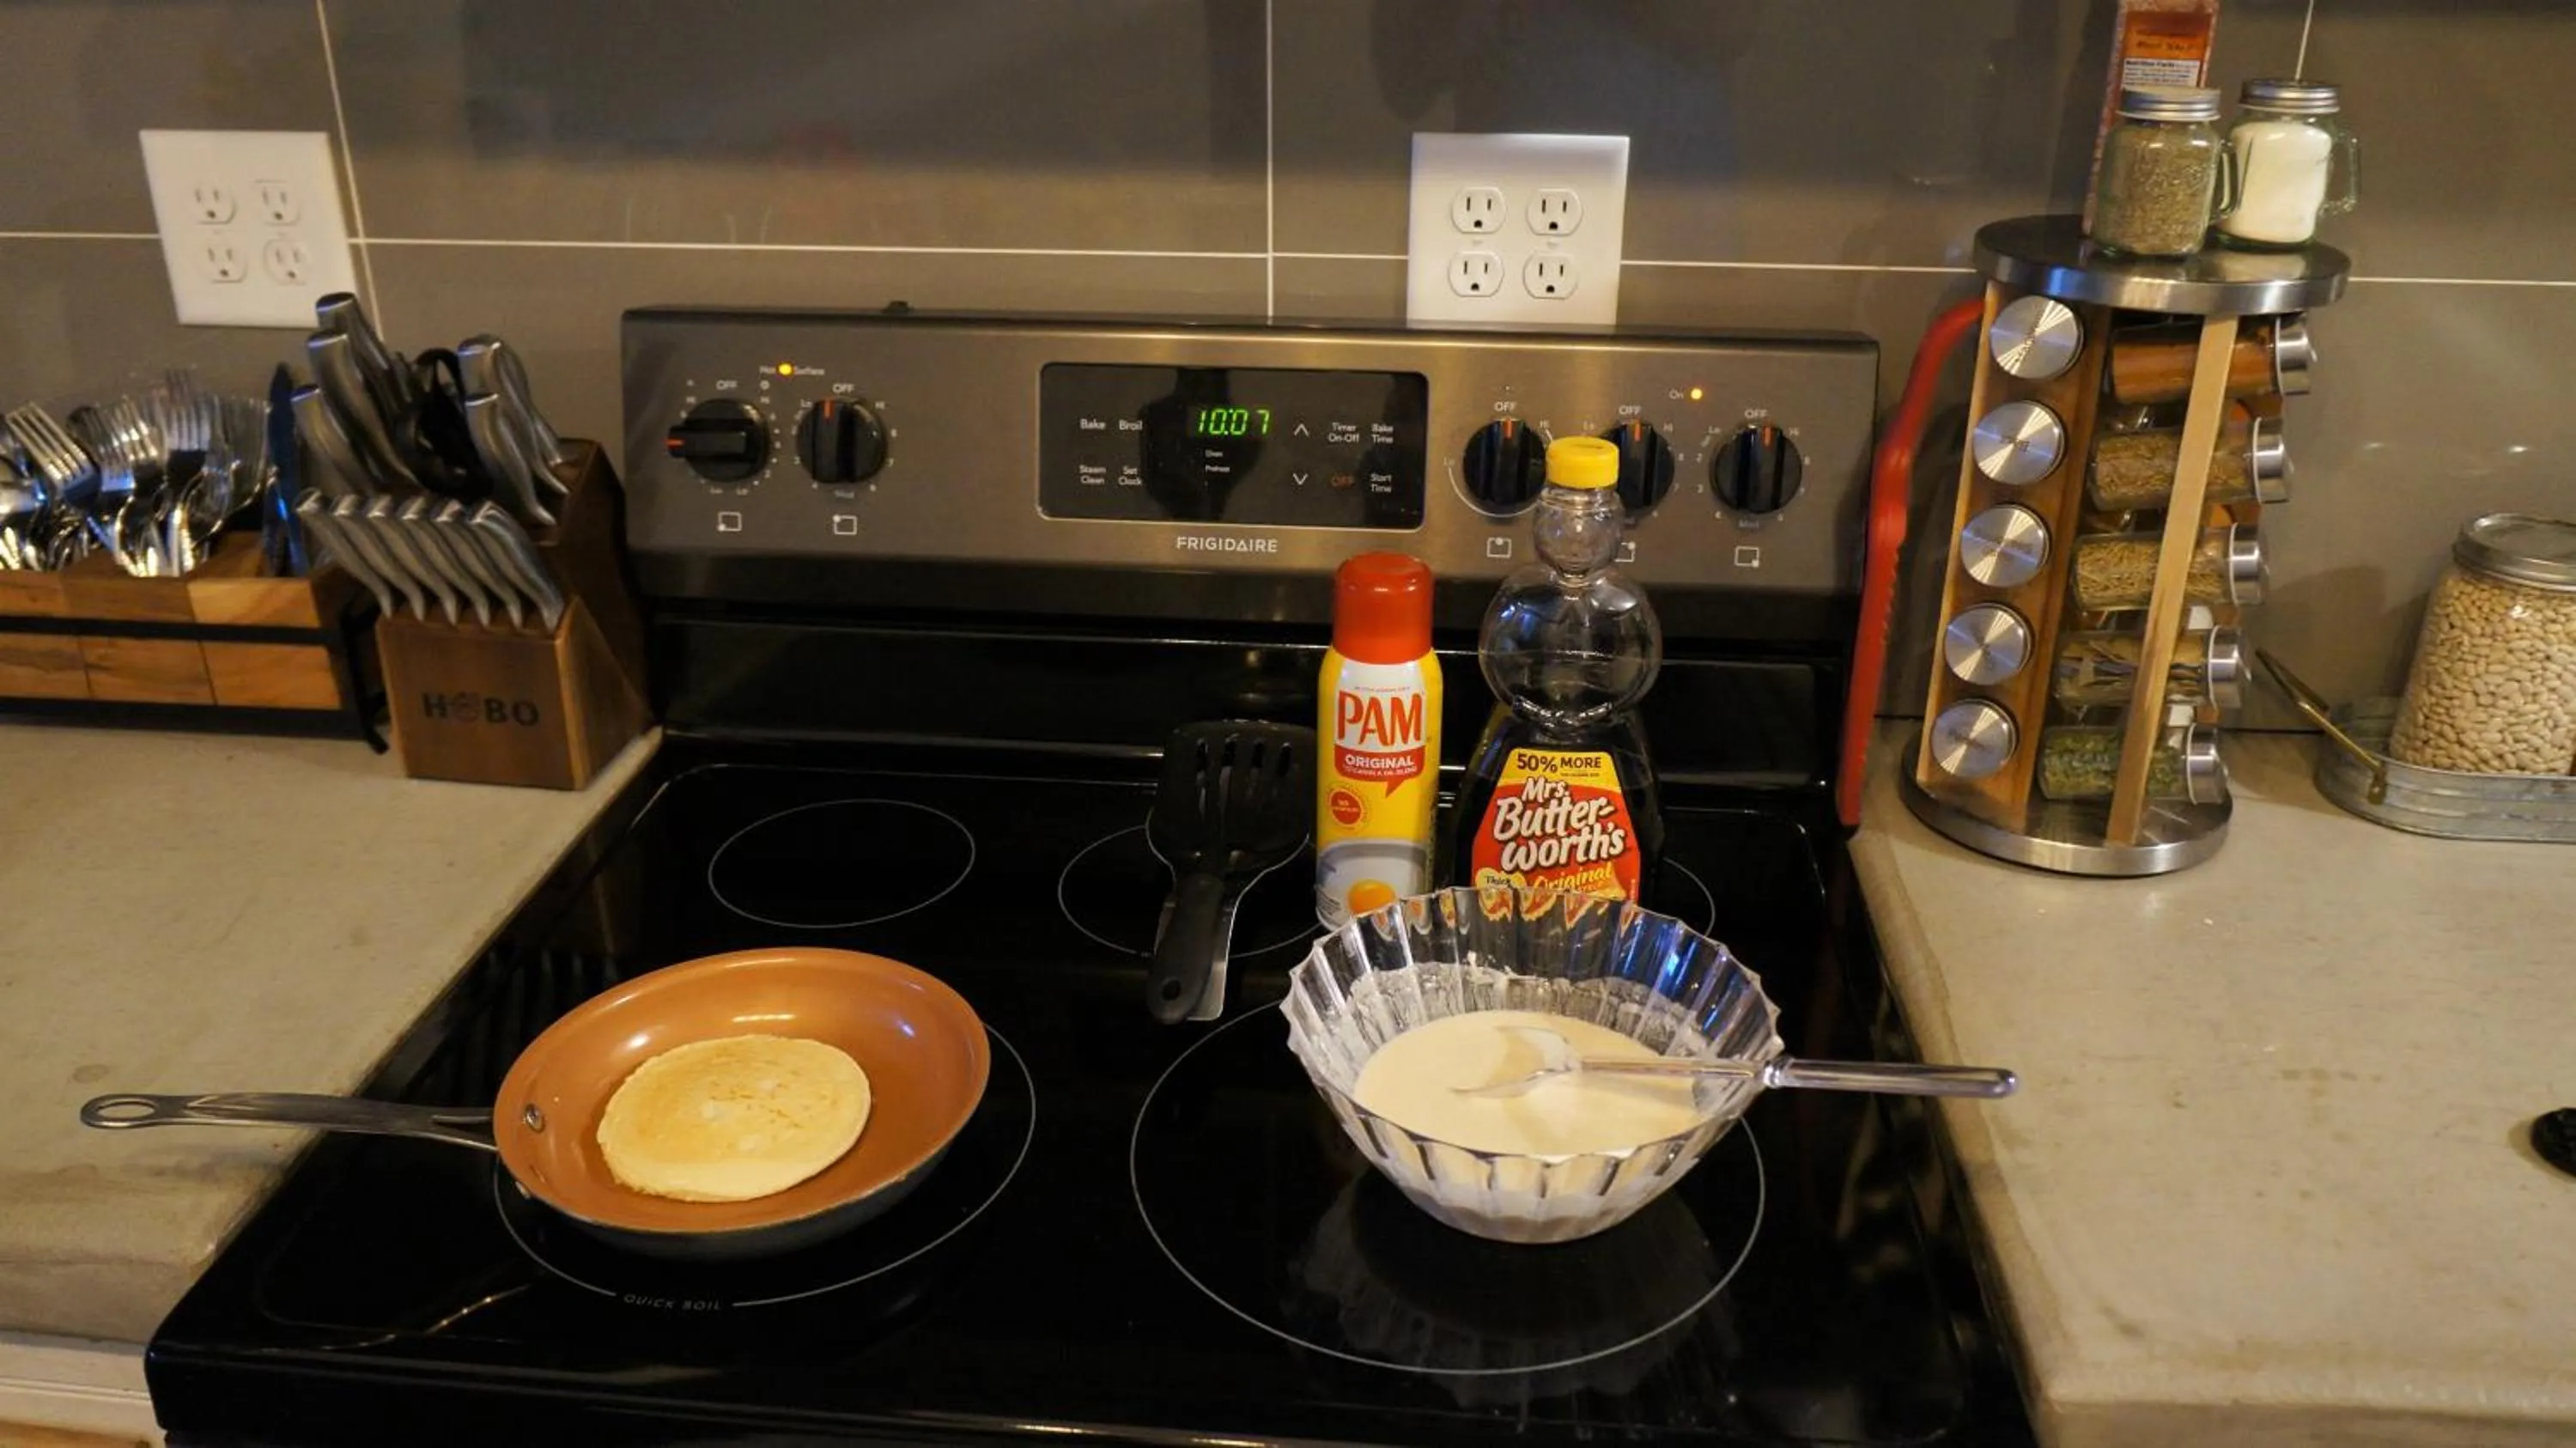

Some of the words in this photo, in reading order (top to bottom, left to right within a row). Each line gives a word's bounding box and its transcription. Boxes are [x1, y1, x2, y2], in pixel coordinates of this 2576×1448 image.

[716, 380, 738, 391] OFF
[832, 383, 854, 394] OFF
[1669, 389, 1685, 400] On
[1494, 400, 1518, 413] OFF
[1618, 405, 1642, 416] OFF
[1744, 408, 1768, 419] OFF
[1079, 417, 1106, 430] Bake
[1118, 418, 1143, 431] Broil
[1332, 422, 1357, 432] Timer
[1371, 423, 1394, 433] Bake
[1328, 433, 1360, 444] On-Off
[1371, 434, 1394, 444] Time
[1079, 465, 1107, 474] Steam
[1122, 465, 1139, 475] Set
[1080, 475, 1105, 485] Clean
[1118, 476, 1143, 486] Clock
[1370, 473, 1393, 483] Start
[1371, 484, 1393, 493] Time
[1176, 535, 1279, 554] FRIGIDAIRE
[1337, 689, 1424, 747] PAM
[1344, 753, 1416, 770] ORIGINAL
[1516, 752, 1558, 774] 50%
[1560, 756, 1602, 769] MORE
[1521, 776, 1571, 804] Mrs.
[1492, 795, 1616, 843] Butter-
[1500, 821, 1625, 873] worth's
[1533, 861, 1613, 892] Original
[623, 1293, 675, 1310] QUICK
[682, 1299, 720, 1311] BOIL
